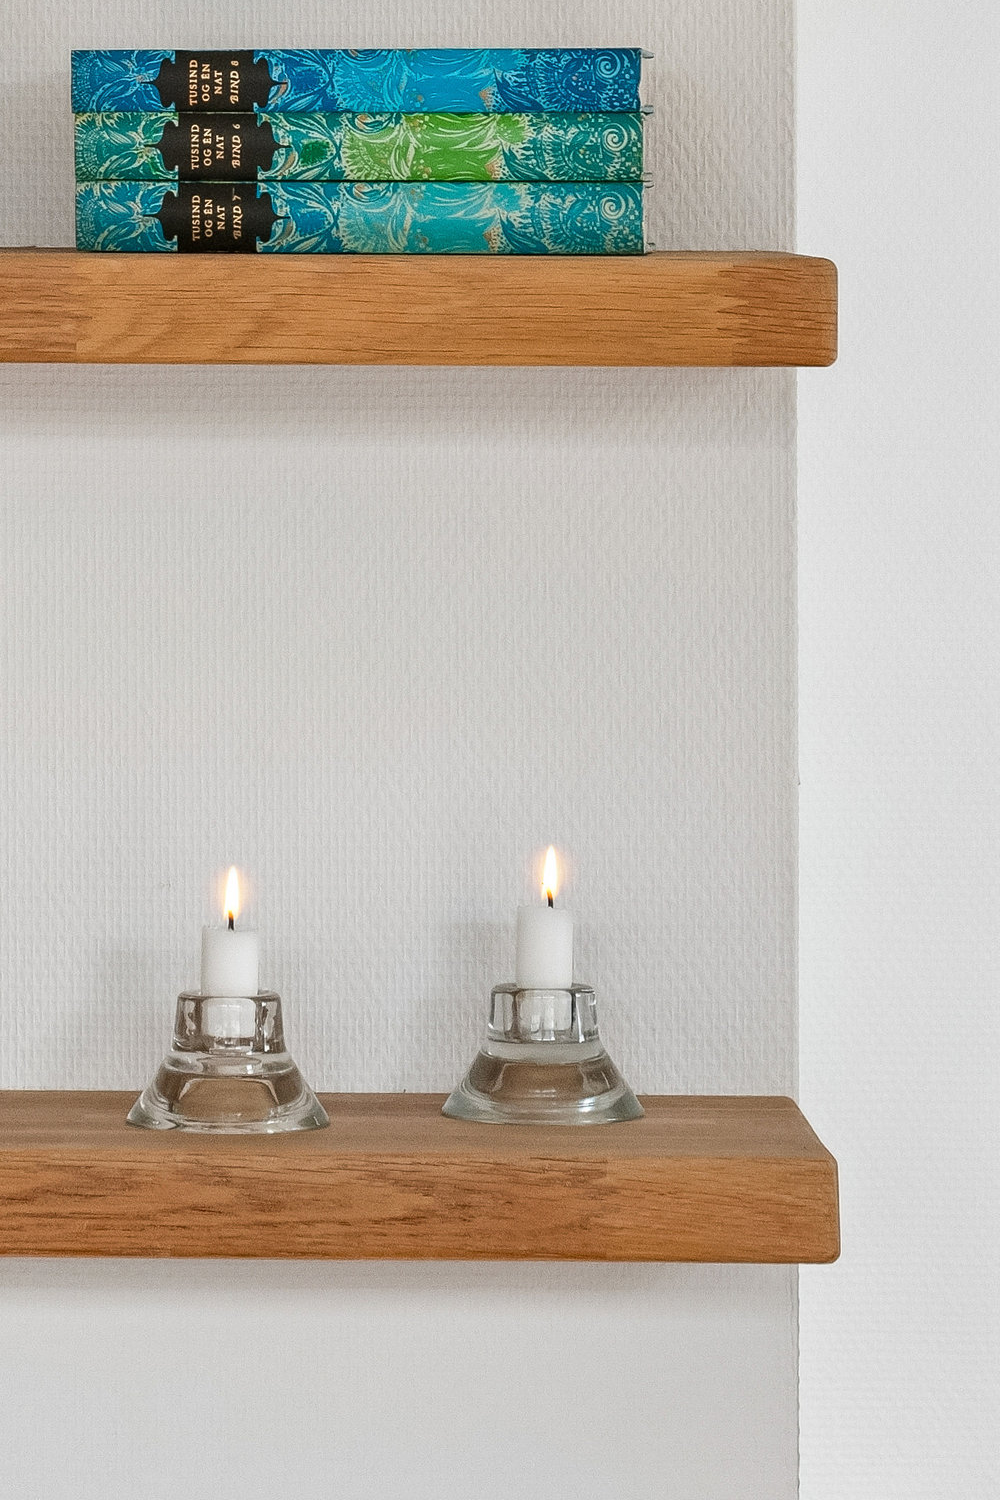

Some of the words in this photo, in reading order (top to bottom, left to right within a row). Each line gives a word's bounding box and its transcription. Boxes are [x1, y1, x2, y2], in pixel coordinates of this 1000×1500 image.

[189, 59, 198, 106] TUSIND
[202, 83, 210, 102] OG
[214, 70, 223, 95] NAT
[230, 70, 240, 104] BIND
[190, 124, 200, 170] TUSIND
[203, 149, 212, 167] OG
[216, 134, 225, 160] NAT
[232, 134, 242, 169] BIND
[192, 194, 201, 242] TUSIND
[204, 219, 214, 238] OG
[216, 205, 226, 230] NAT
[232, 205, 244, 240] BIND
